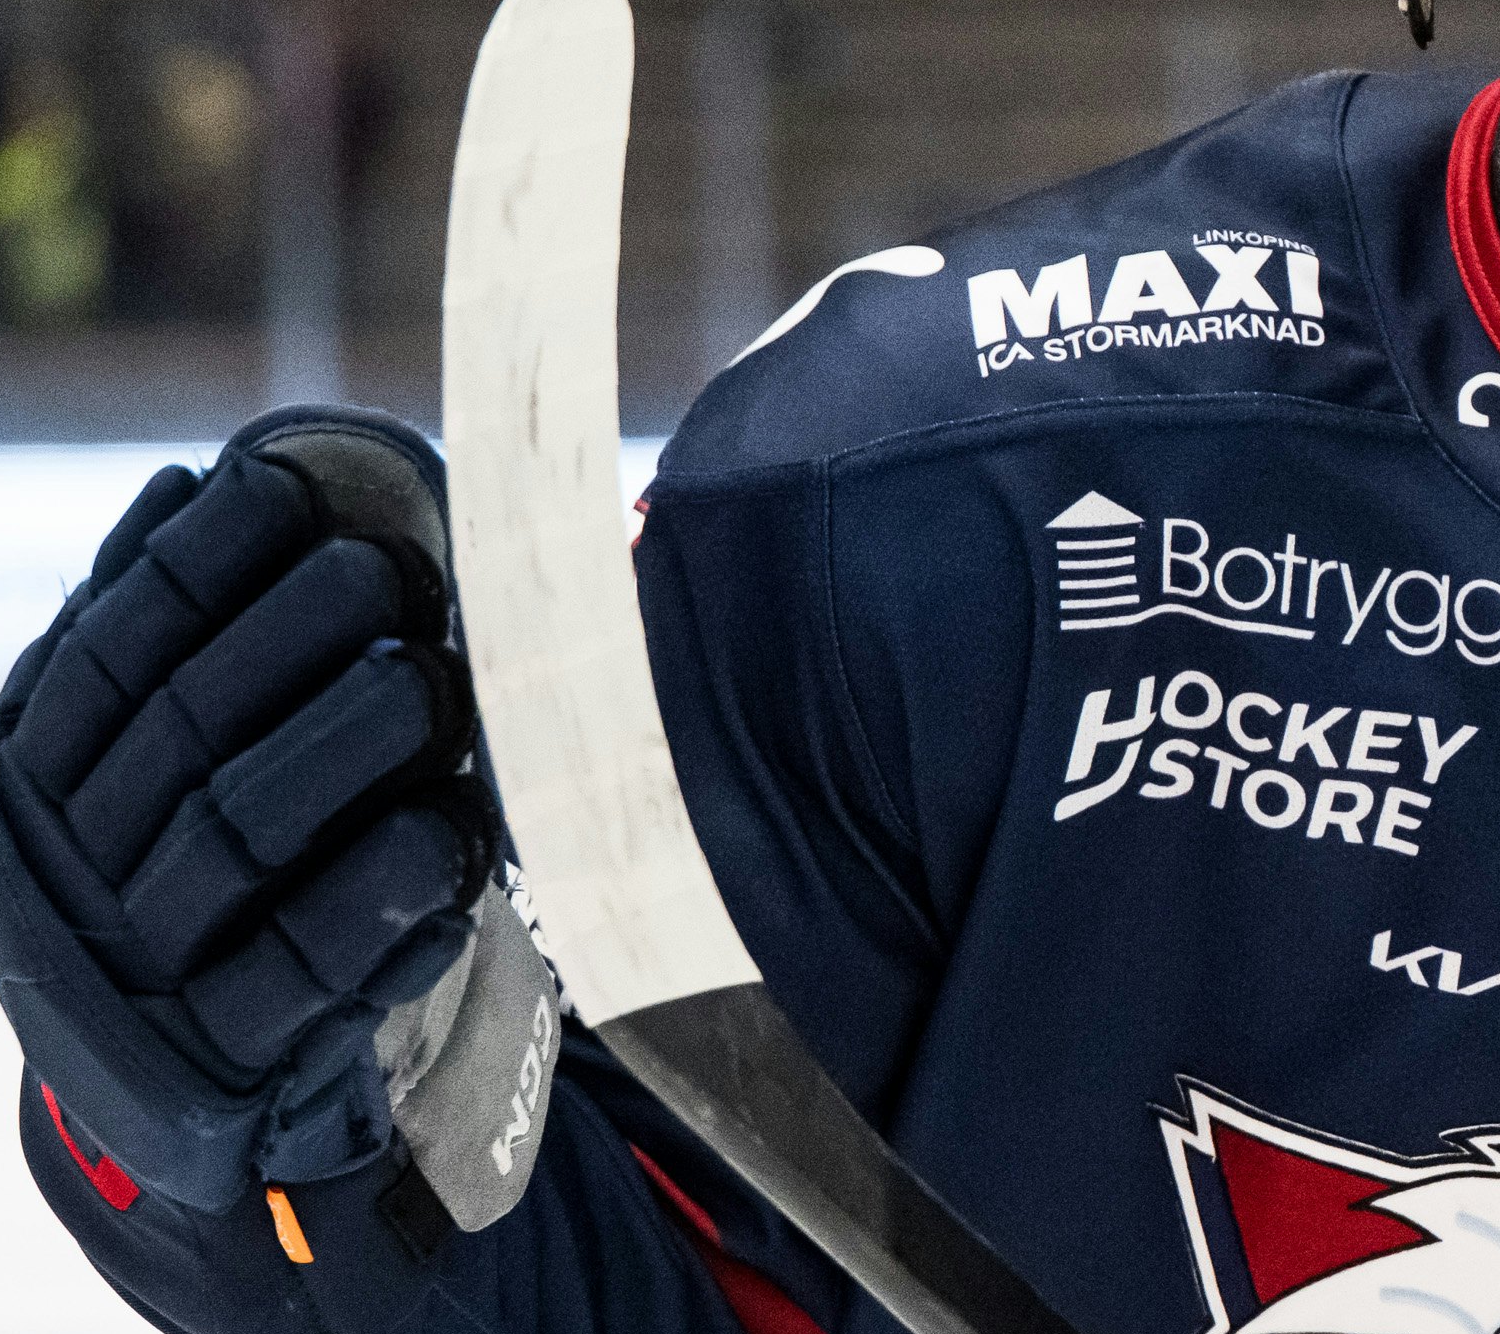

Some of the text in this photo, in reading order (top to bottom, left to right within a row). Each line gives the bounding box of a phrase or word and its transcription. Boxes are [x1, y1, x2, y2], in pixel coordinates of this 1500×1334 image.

[1192, 229, 1316, 255] LINKÖPING
[967, 244, 1324, 350] MAXI
[977, 312, 1325, 378] ICA STORMARKNAD
[1054, 670, 1479, 821] HOCKEY
[1139, 738, 1433, 857] STORE
